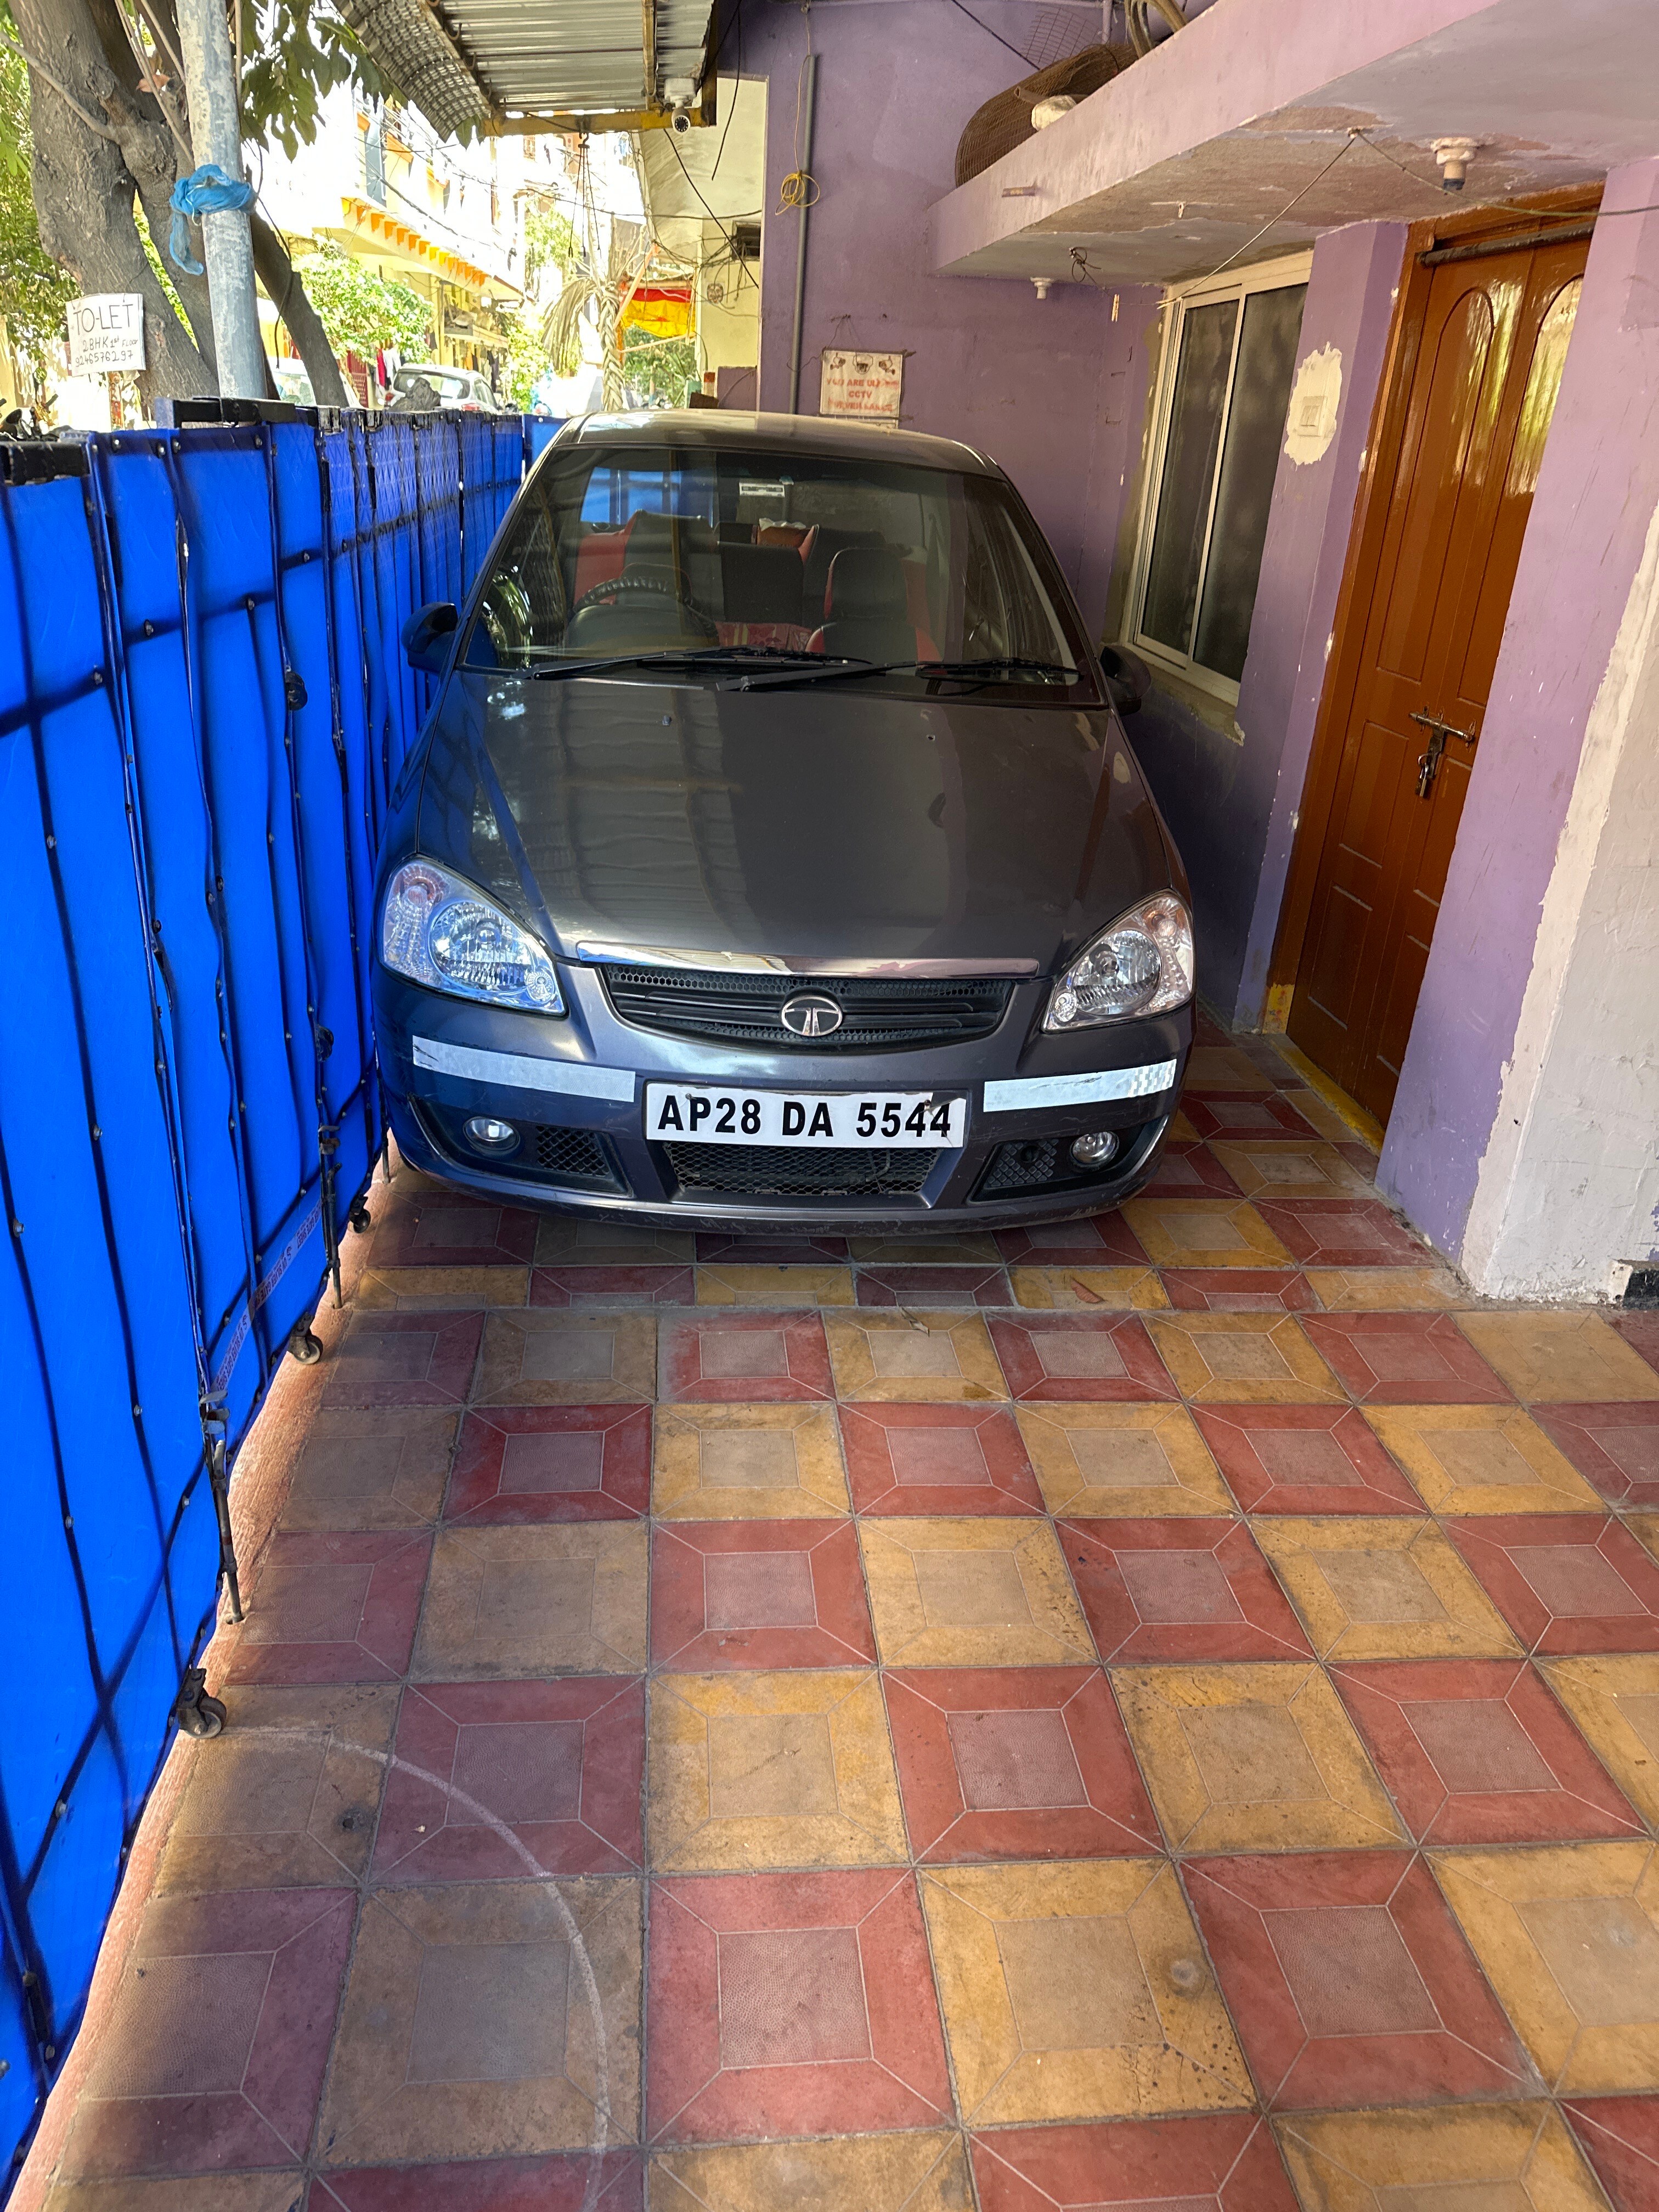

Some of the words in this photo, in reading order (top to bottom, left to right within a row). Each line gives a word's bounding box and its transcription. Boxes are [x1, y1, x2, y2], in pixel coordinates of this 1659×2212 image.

[73, 304, 133, 335] TO-LET
[83, 336, 109, 352] 2BHK
[75, 350, 133, 367] 9246576297
[847, 378, 864, 387] ARE
[849, 390, 873, 399] CCTV
[658, 1094, 761, 1135] AP28
[782, 1101, 834, 1137] DA
[855, 1102, 951, 1138] 5544
